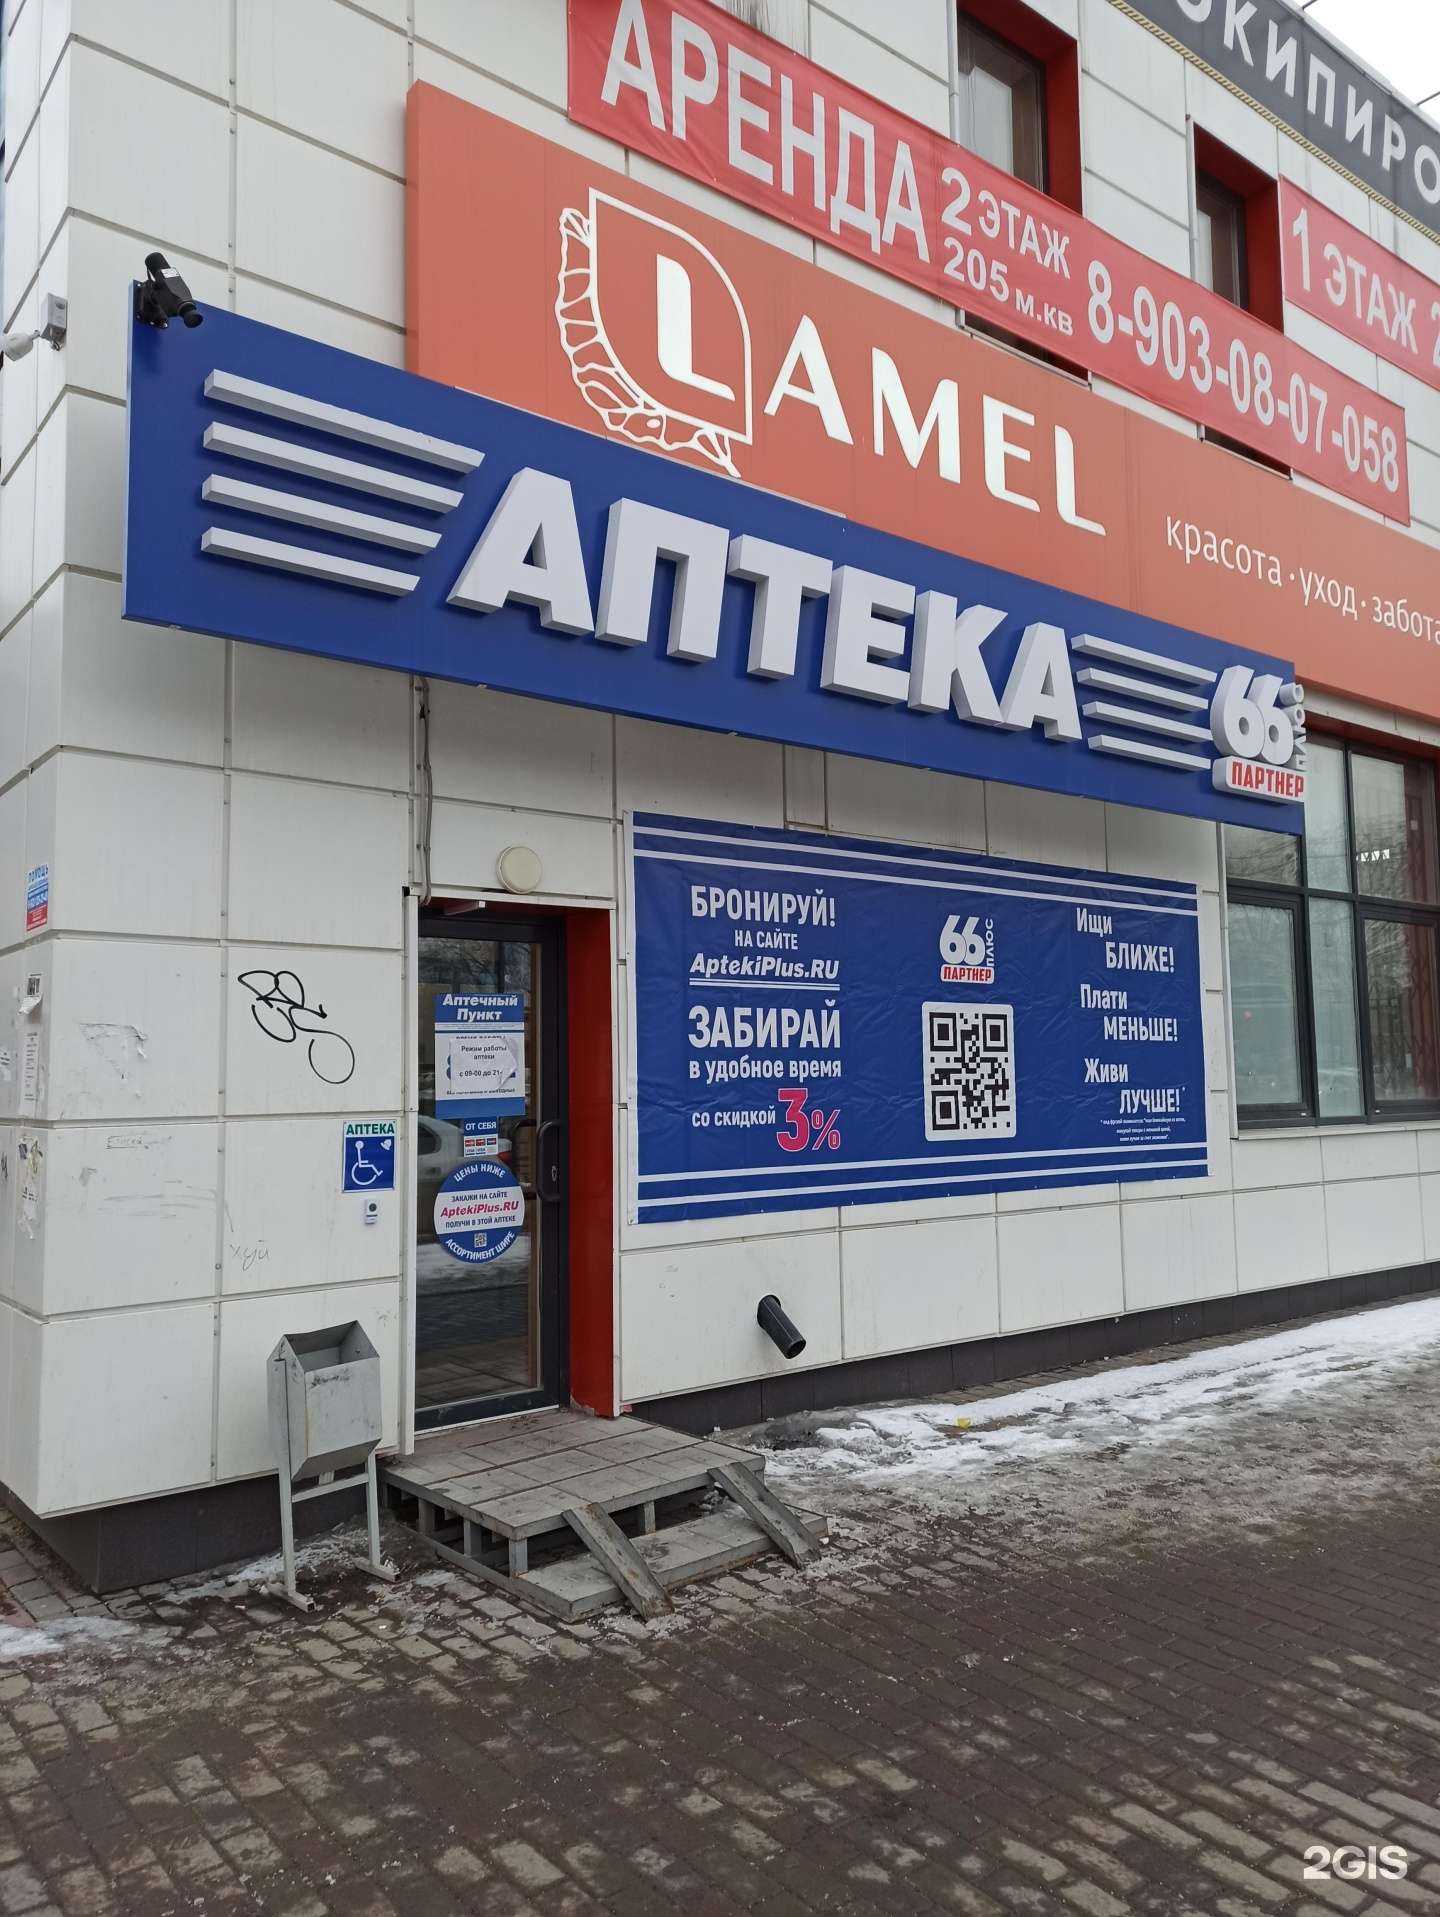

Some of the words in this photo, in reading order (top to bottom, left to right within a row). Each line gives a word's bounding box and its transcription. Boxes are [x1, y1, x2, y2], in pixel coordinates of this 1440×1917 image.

[601, 0, 931, 263] АРЕНДА
[941, 167, 972, 236] 2
[978, 190, 1070, 279] ЭТАЖ
[944, 236, 1009, 302] 205
[1016, 288, 1073, 336] м.кв
[1292, 208, 1311, 292] 1
[1323, 243, 1418, 354] ЭТАЖ
[1088, 260, 1399, 493] 8-903-08-07-058
[656, 254, 1107, 537] LAMEL
[1166, 516, 1282, 587] красота
[1300, 567, 1358, 621] уход
[447, 466, 1083, 743] АПТЕКА
[1210, 665, 1294, 765] 66
[1232, 761, 1304, 797] ПАРТНЕР
[691, 885, 836, 927] БРОНИРУЙ!
[1076, 907, 1113, 938] Ищи
[734, 929, 754, 948] НА
[756, 928, 799, 950] САЙТЕ
[940, 914, 985, 965] 66
[985, 918, 995, 967] ПЛЮС
[689, 952, 840, 980] AptekiPlus.RU
[1105, 941, 1175, 973] БЛИЖЕ!
[943, 966, 992, 981] ПАРТНЕР
[442, 994, 518, 1007] Аптечный
[1080, 983, 1128, 1010] Плати
[456, 1008, 502, 1022] Пункт
[688, 999, 841, 1048] ЗАБИРАЙ
[1103, 1016, 1178, 1042] МЕНЬШЕ!
[689, 1060, 700, 1079] в
[705, 1054, 784, 1084] удобное
[789, 1060, 842, 1083] время
[1084, 1057, 1129, 1083] Живи
[346, 1123, 395, 1136] АПТЕКА
[465, 1122, 476, 1131] ОТ
[478, 1121, 497, 1130] СЕБЯ
[692, 1111, 710, 1127] со
[714, 1105, 776, 1128] скидкой
[776, 1088, 841, 1152] 3%
[454, 1164, 479, 1182] ЦЕНЫ
[480, 1163, 506, 1179] НИЖЕ
[441, 1201, 519, 1218] AptekiPlus.RU
[452, 1193, 479, 1202] ЗАКАЖИ
[480, 1192, 488, 1200] НА
[489, 1190, 508, 1199] САЙТЕ
[445, 1219, 471, 1229] ПОЛУЧИ
[477, 1216, 493, 1225] ЭТОЙ
[494, 1215, 516, 1224] АПТЕКЕ
[445, 1239, 496, 1261] АССОРТИМЕНТ
[494, 1231, 516, 1252] ШИРЕ
